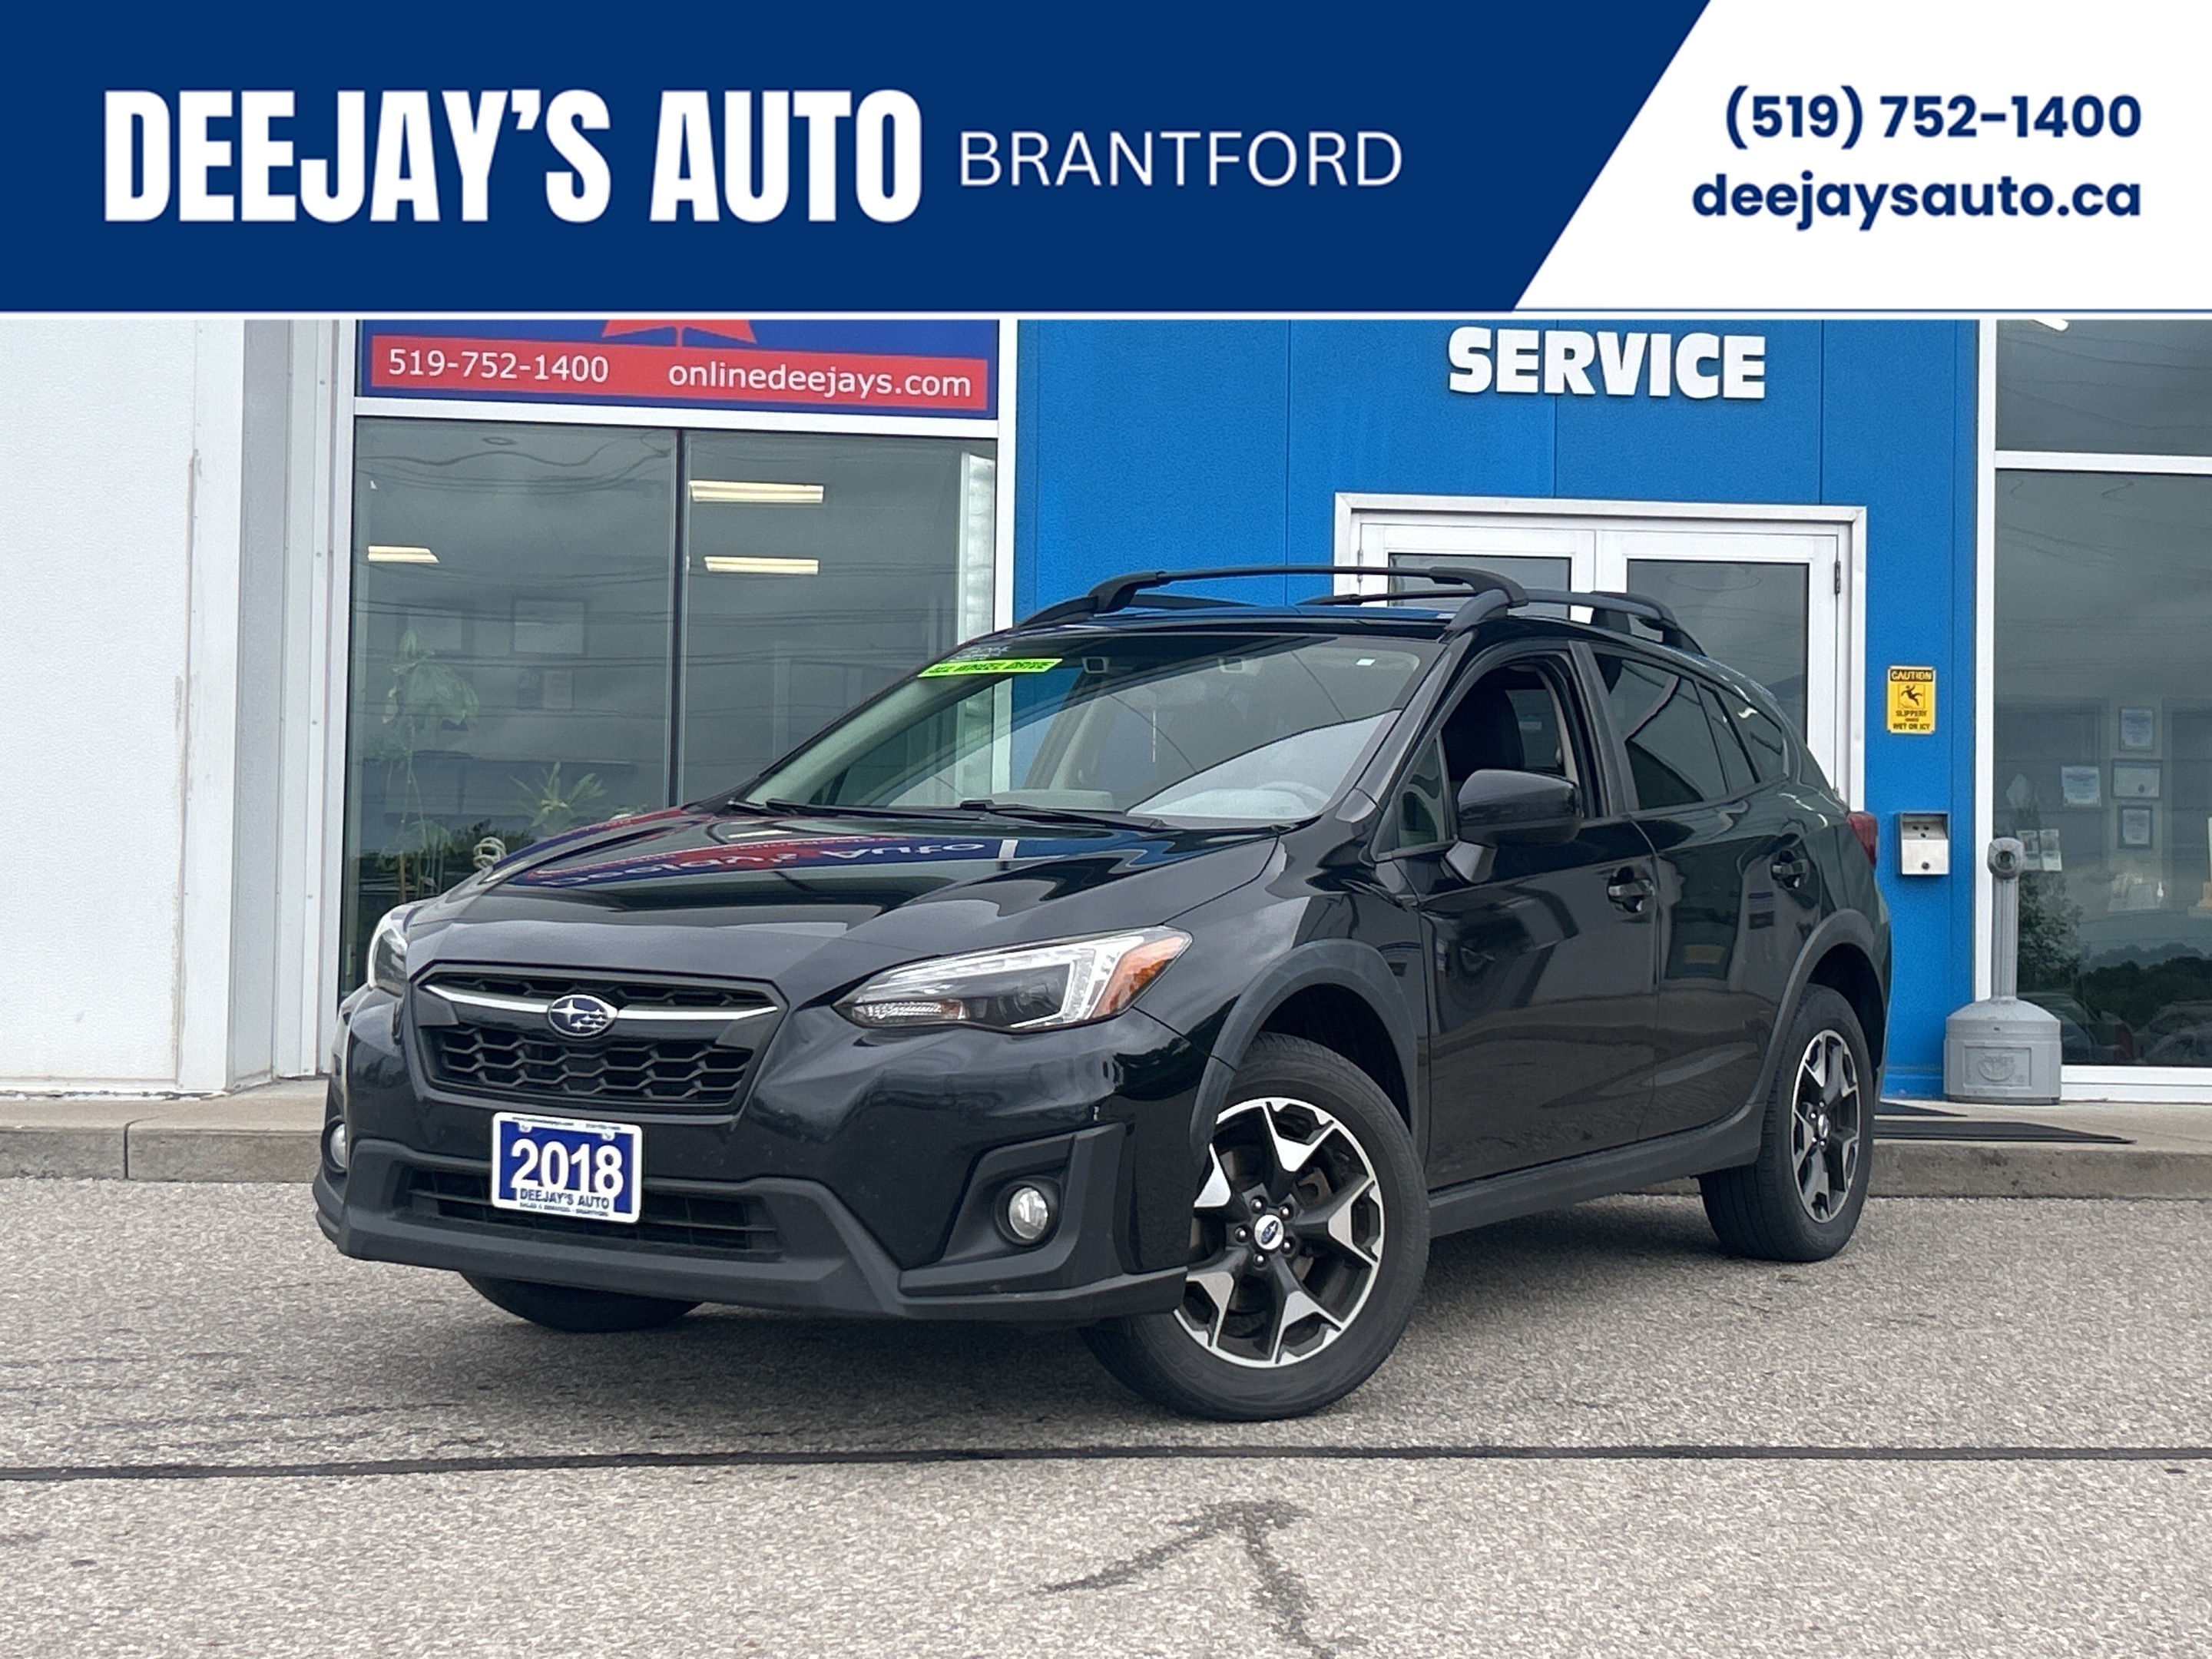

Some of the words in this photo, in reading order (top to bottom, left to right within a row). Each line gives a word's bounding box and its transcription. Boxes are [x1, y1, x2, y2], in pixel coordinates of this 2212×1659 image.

[388, 349, 608, 382] 519-752-1400
[667, 360, 972, 399] onlinedeejays.com
[1449, 326, 1766, 399] SERVICE
[1892, 671, 1932, 680] CAUTION
[510, 1138, 624, 1198] 2018
[520, 1187, 574, 1207] DEEJAY'S
[578, 1194, 611, 1210] AUTO
